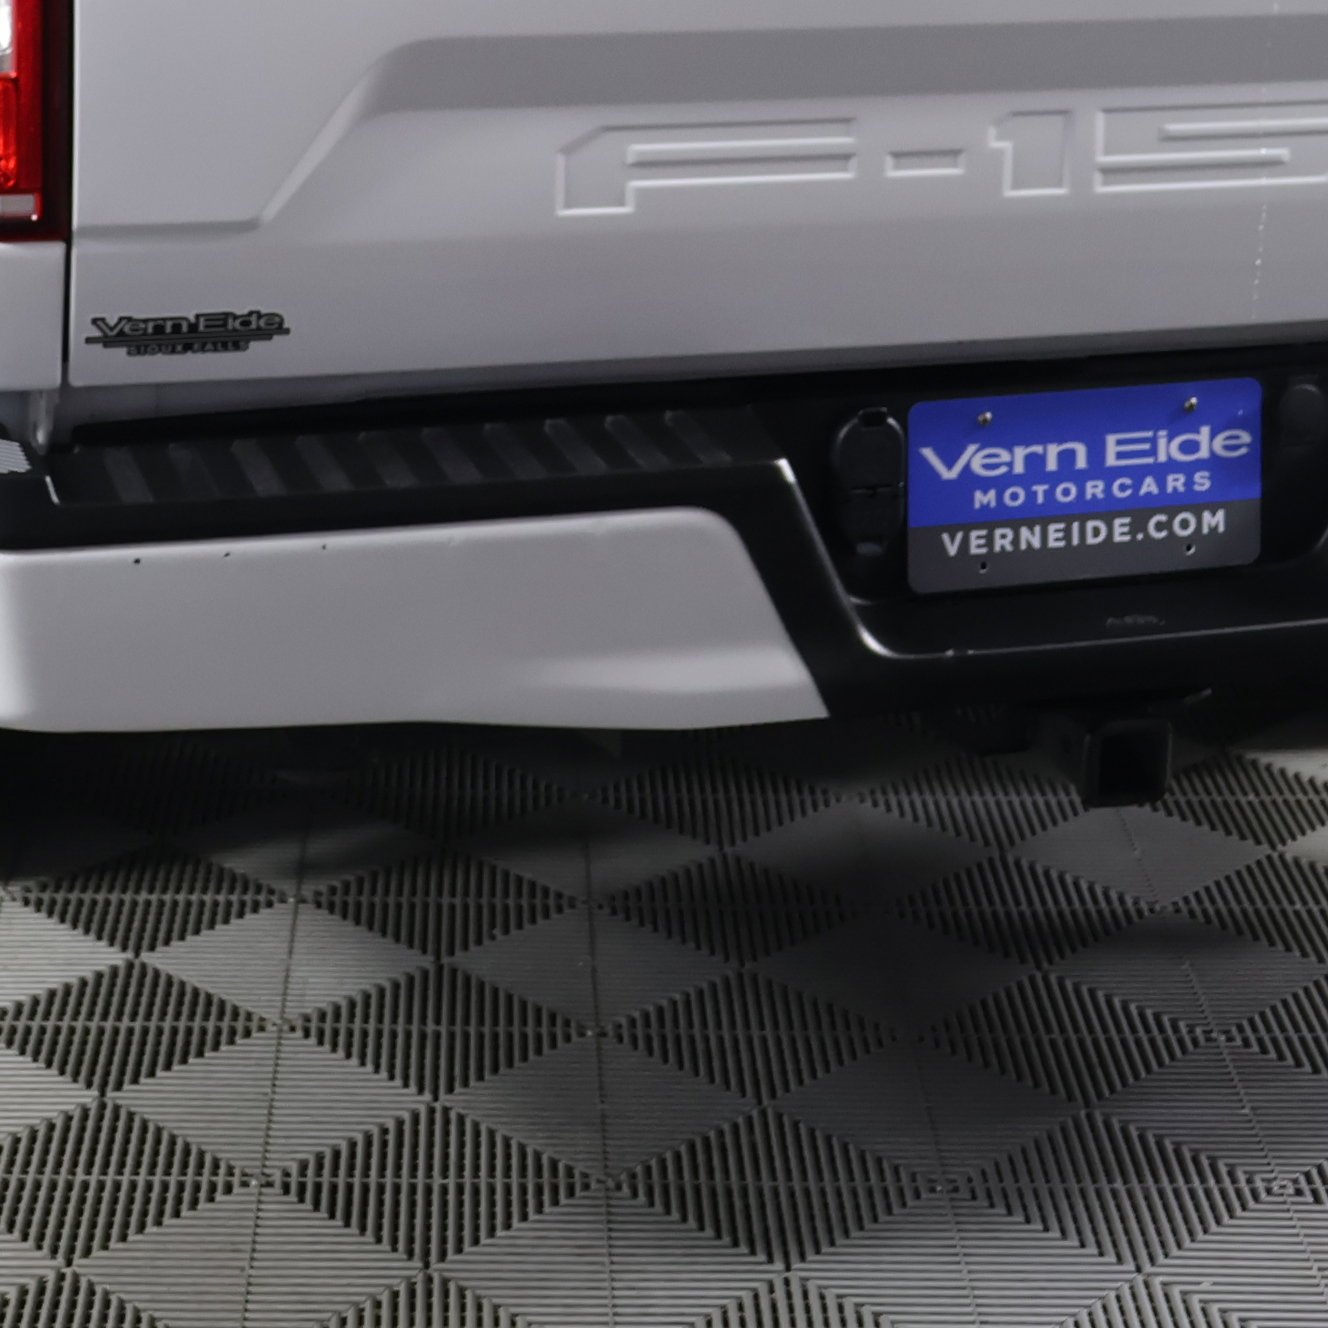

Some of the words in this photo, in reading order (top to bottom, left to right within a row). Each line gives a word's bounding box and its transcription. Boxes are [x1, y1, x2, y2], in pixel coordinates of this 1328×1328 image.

[92, 316, 189, 337] Vern
[194, 310, 284, 332] Eide
[919, 442, 1088, 480] Vern
[1104, 425, 1252, 468] Eide
[974, 471, 1212, 509] MOTORCARS
[941, 509, 1226, 557] VERNEIDE.COM
